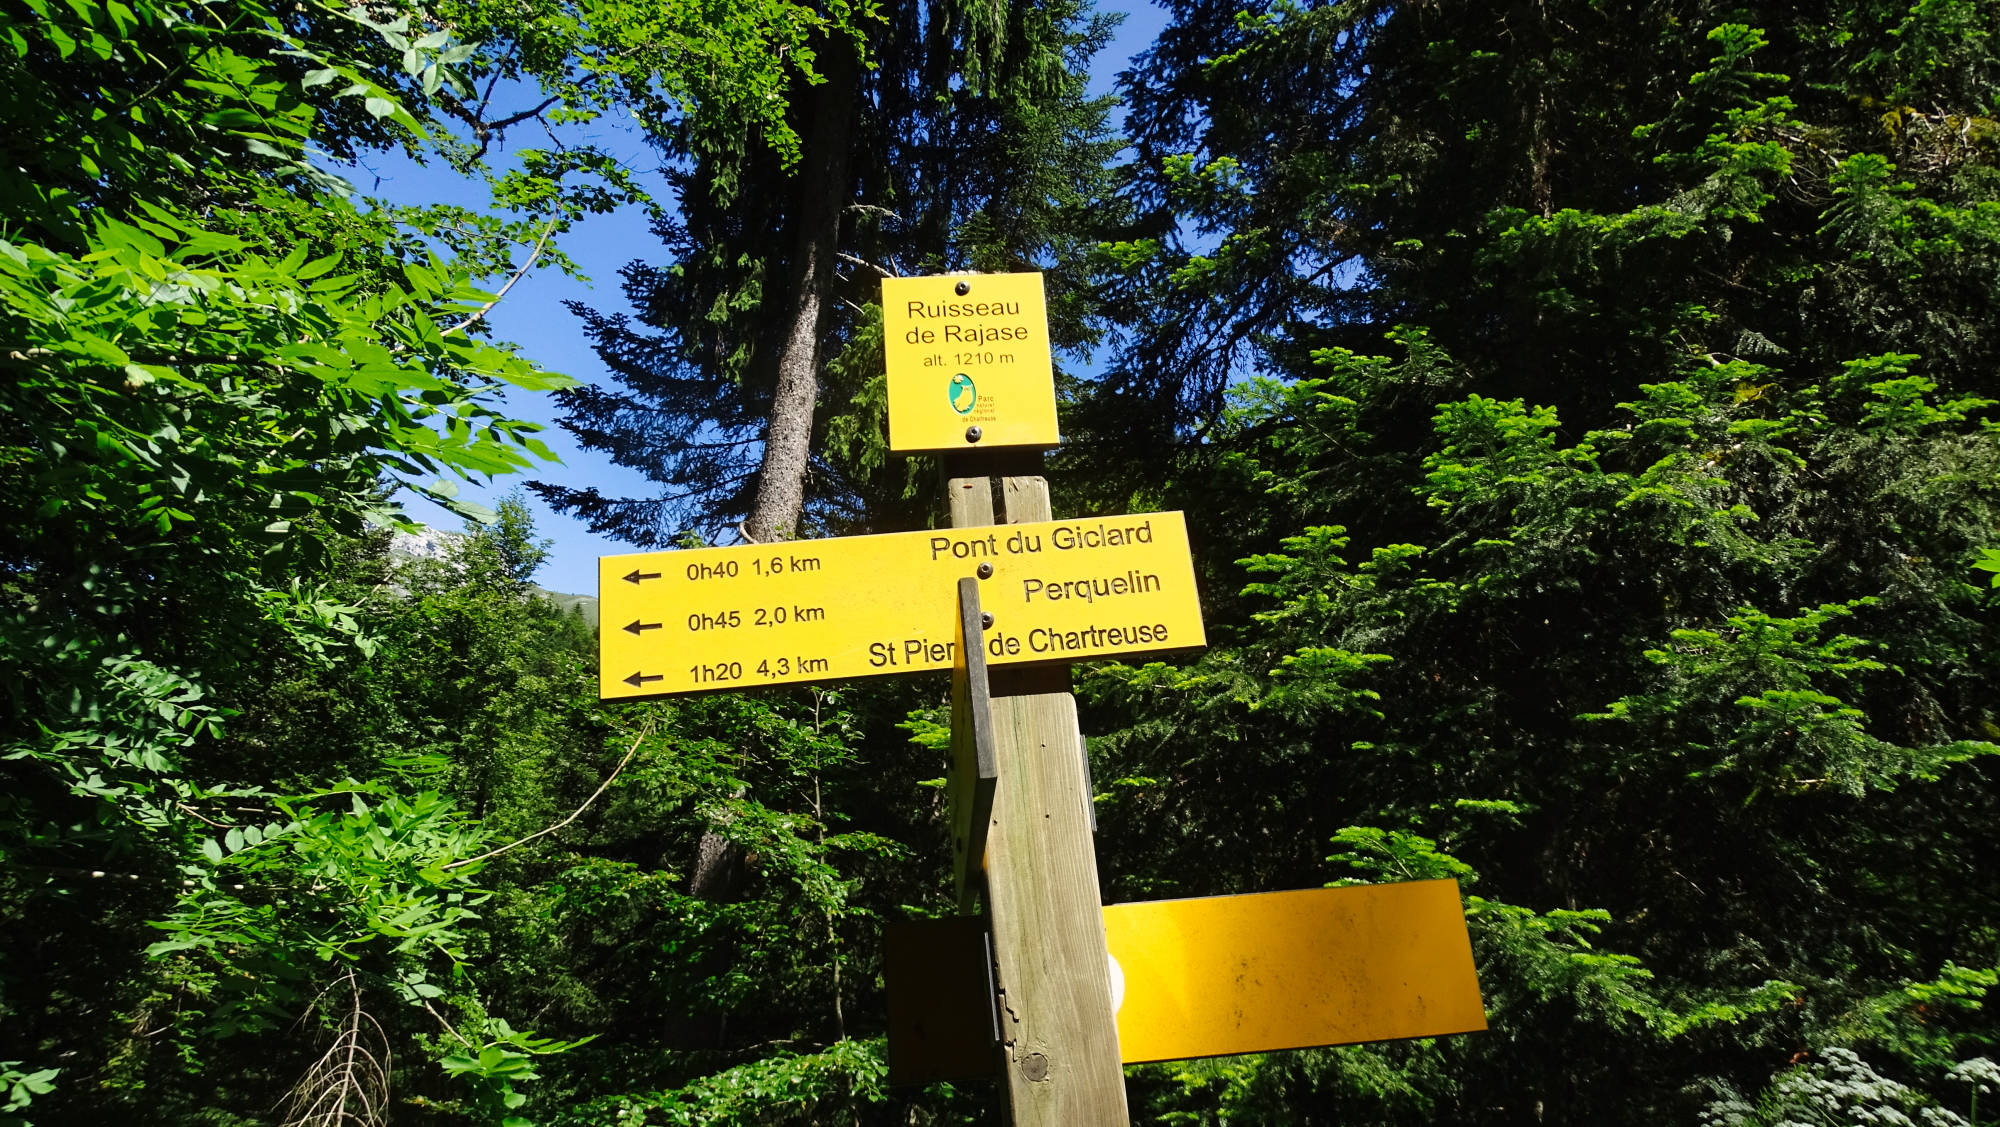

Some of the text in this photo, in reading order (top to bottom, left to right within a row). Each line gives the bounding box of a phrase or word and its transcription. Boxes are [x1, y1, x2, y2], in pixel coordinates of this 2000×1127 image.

[907, 300, 1020, 319] Ruisseau
[905, 324, 1028, 346] de Rajase
[923, 352, 1014, 367] alt. 1210 m
[978, 395, 994, 403] Parc
[930, 520, 1153, 561] Pont du Giclard
[686, 556, 821, 581] 0h40 1,6 km
[1023, 570, 1161, 604] Perquelin
[687, 605, 825, 632] 0h45 2,0 km
[869, 623, 1168, 668] St Pier de Chartreuse
[690, 656, 829, 683] 1h20 4,3 km
